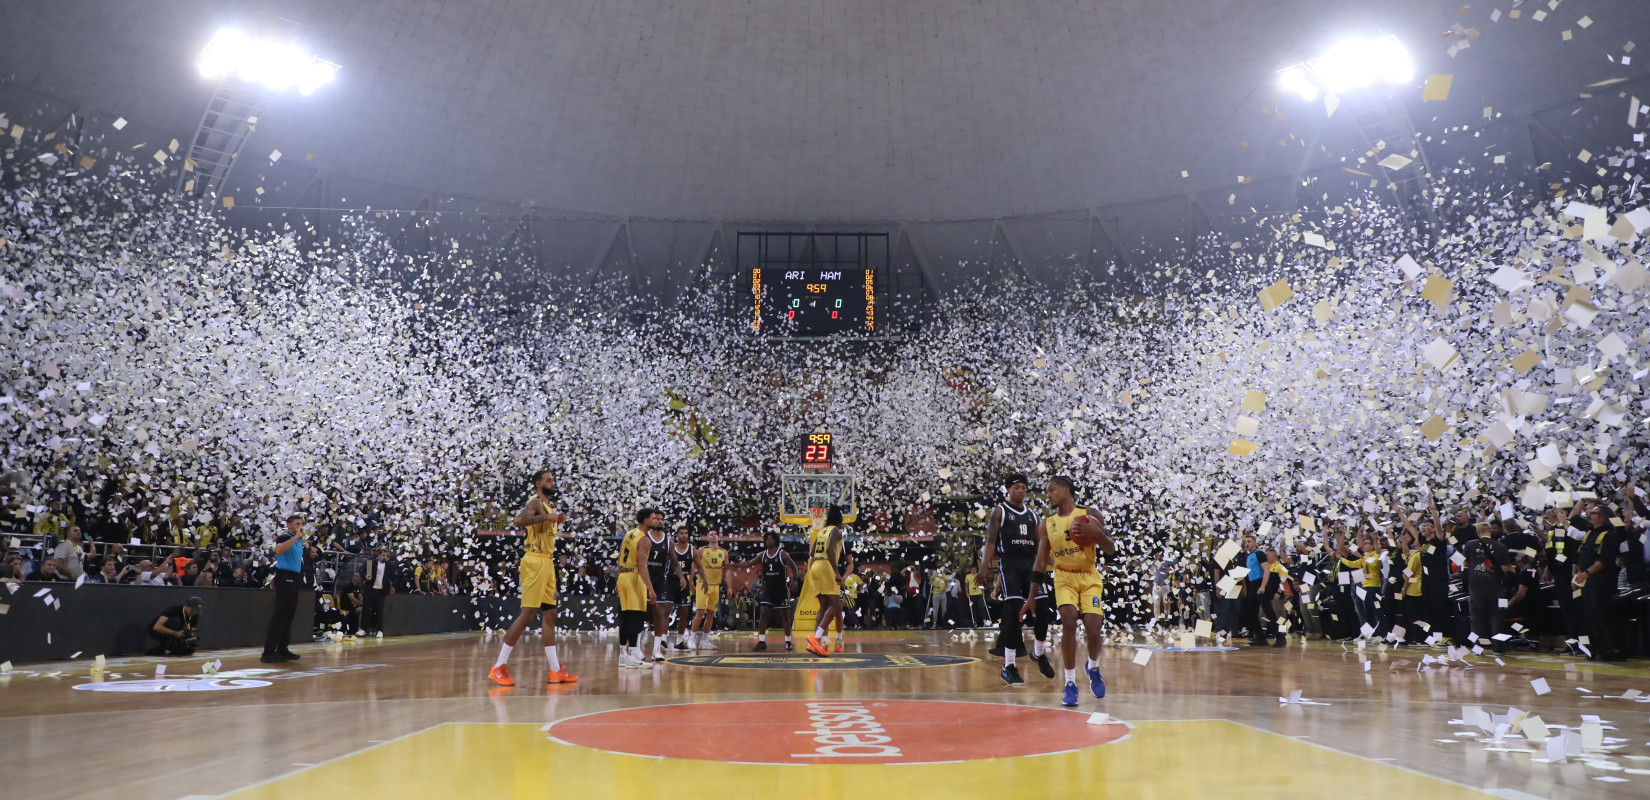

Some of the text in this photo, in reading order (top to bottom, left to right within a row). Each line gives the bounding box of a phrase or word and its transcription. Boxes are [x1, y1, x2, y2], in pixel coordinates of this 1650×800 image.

[785, 271, 841, 280] ARI HAM
[806, 284, 826, 293] 9:59
[793, 299, 800, 308] 0
[835, 299, 842, 308] 0
[788, 310, 795, 319] 0
[832, 310, 838, 319] 0
[810, 434, 830, 444] 9:59
[806, 445, 828, 460] 23
[1018, 524, 1028, 535] 19
[816, 542, 825, 553] 23
[653, 551, 659, 559] 7
[790, 702, 904, 758] betsson
